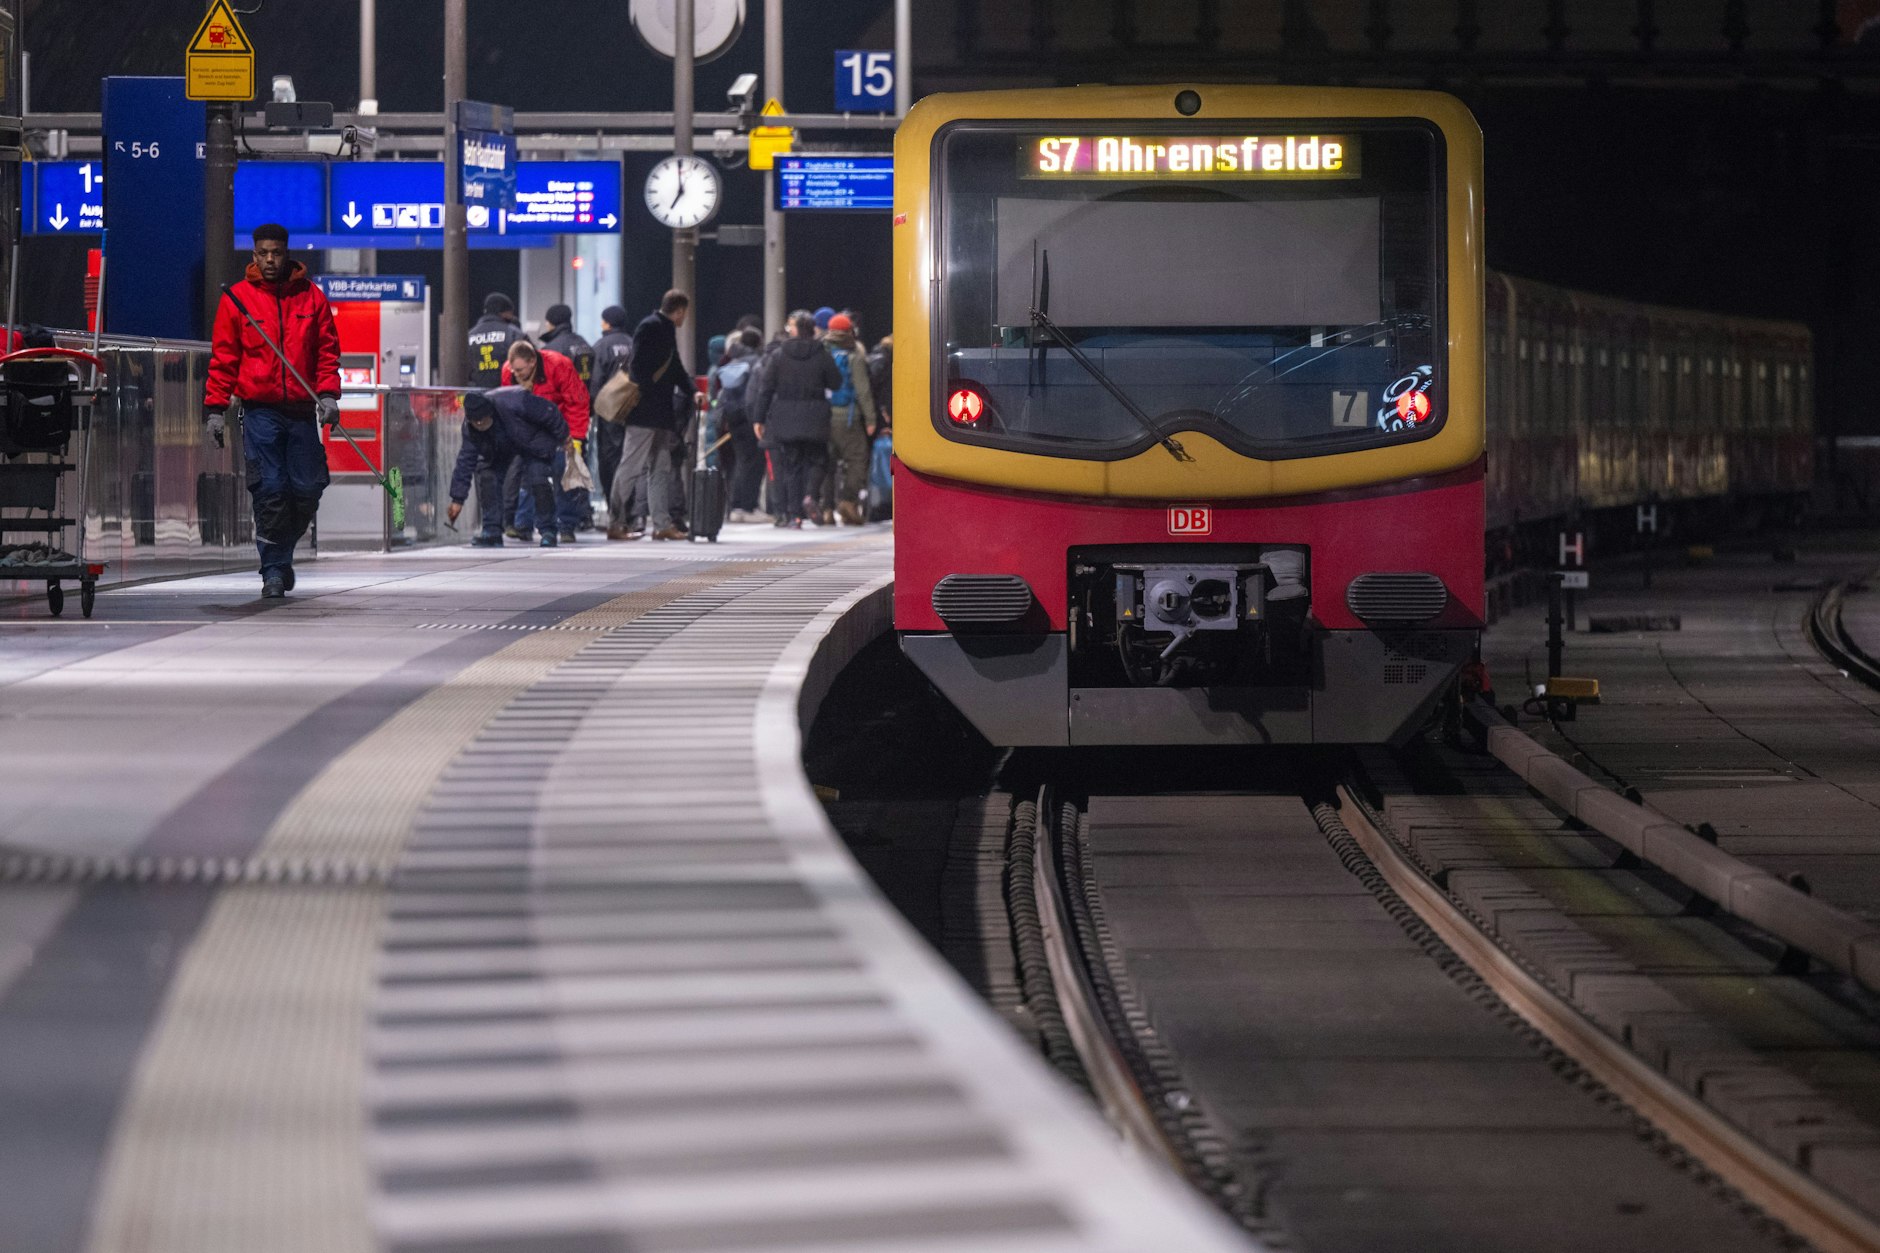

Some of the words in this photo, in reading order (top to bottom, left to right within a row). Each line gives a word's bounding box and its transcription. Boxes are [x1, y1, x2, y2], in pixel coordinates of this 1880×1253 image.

[842, 53, 893, 96] 15
[131, 142, 160, 159] 5-6
[1039, 137, 1080, 172] S7
[1097, 136, 1343, 172] Ahrensfelde
[328, 280, 398, 292] VBB-Fahrkarten
[468, 331, 506, 346] POLIZEI
[1339, 391, 1358, 423] 7
[1174, 510, 1206, 530] DB
[1637, 504, 1657, 532] H
[1559, 532, 1583, 566] H
